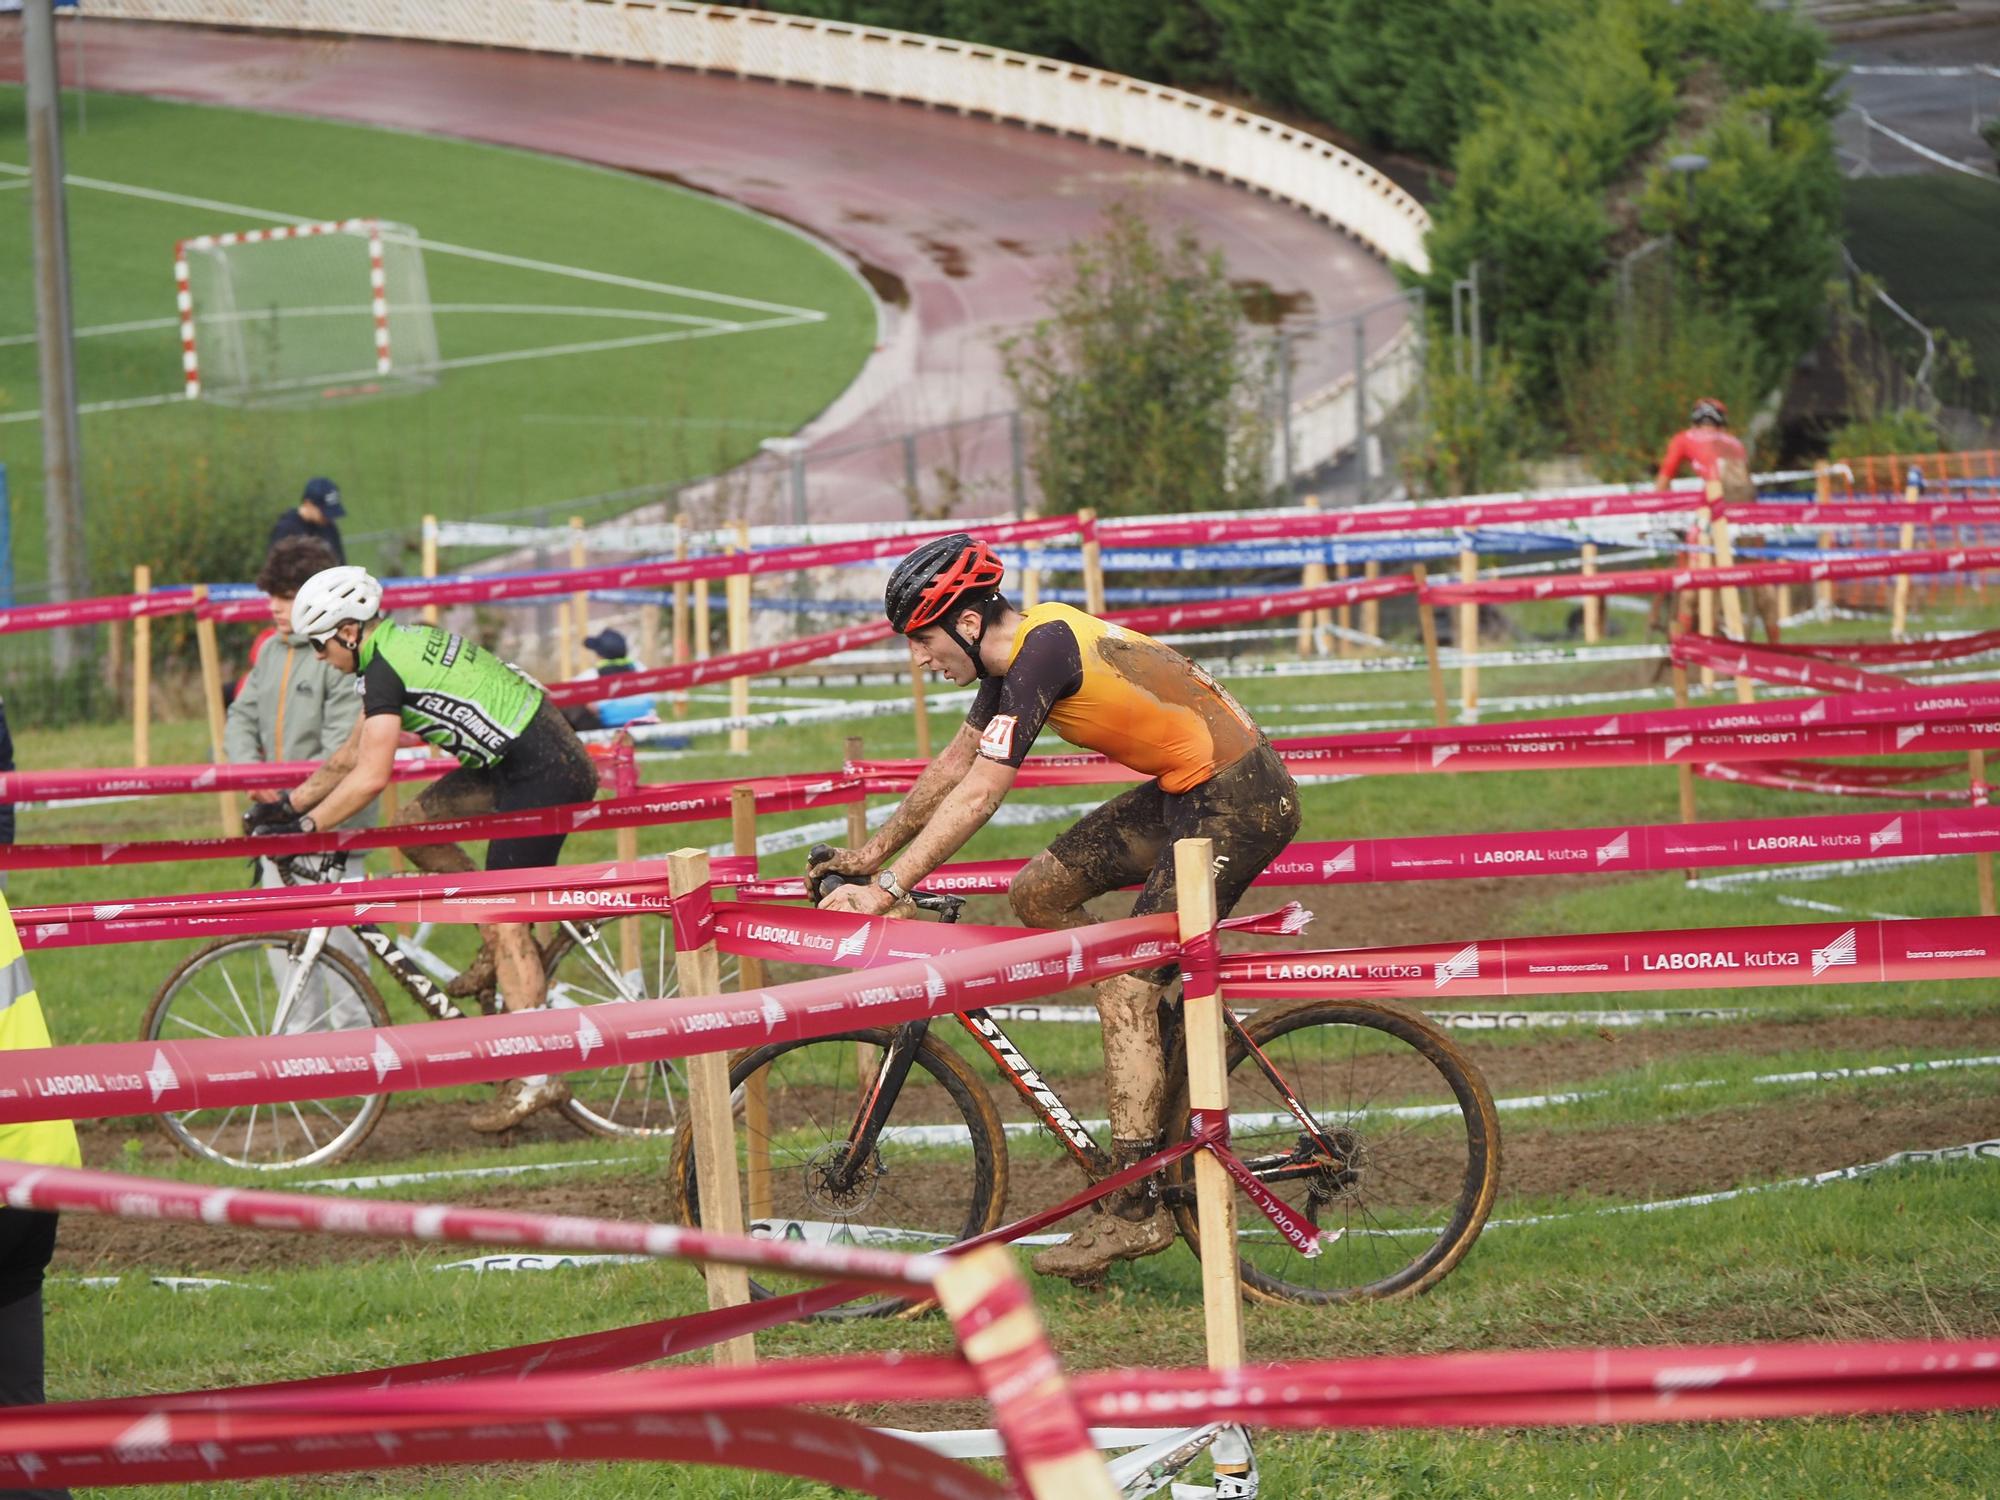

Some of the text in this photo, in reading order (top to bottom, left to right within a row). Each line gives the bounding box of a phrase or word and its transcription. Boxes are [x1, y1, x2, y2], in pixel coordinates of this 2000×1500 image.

[1914, 698, 1968, 712] LABORAL
[1708, 716, 1761, 730] LABORAL
[983, 719, 1012, 745] 27
[1738, 732, 1796, 745] LABORAL
[1505, 741, 1565, 753] LABORAL
[97, 779, 151, 791] LABORAL
[645, 799, 705, 813] LABORAL
[1748, 833, 1861, 851] LABORAL kutxa
[1474, 848, 1588, 864] LABORAL kutxa
[1274, 861, 1313, 873] kutxa
[926, 876, 996, 891] LABORAL
[548, 891, 636, 907] LABORAL
[747, 924, 834, 950] LABORAL kutxa
[1643, 953, 1739, 970] LABORAL
[1744, 950, 1799, 967] kutxa
[1005, 960, 1044, 982] LABORAL
[1266, 964, 1362, 979] LABORAL
[1367, 963, 1422, 978] kutxa
[854, 987, 900, 1007] LABORAL
[681, 1012, 732, 1034] LABORAL
[485, 1035, 543, 1057] LABORAL
[272, 1056, 335, 1078] LABORAL
[335, 1054, 369, 1073] kutxa
[36, 1073, 144, 1097] LABORAL kutxa
[970, 1018, 1097, 1148] STEVENS
